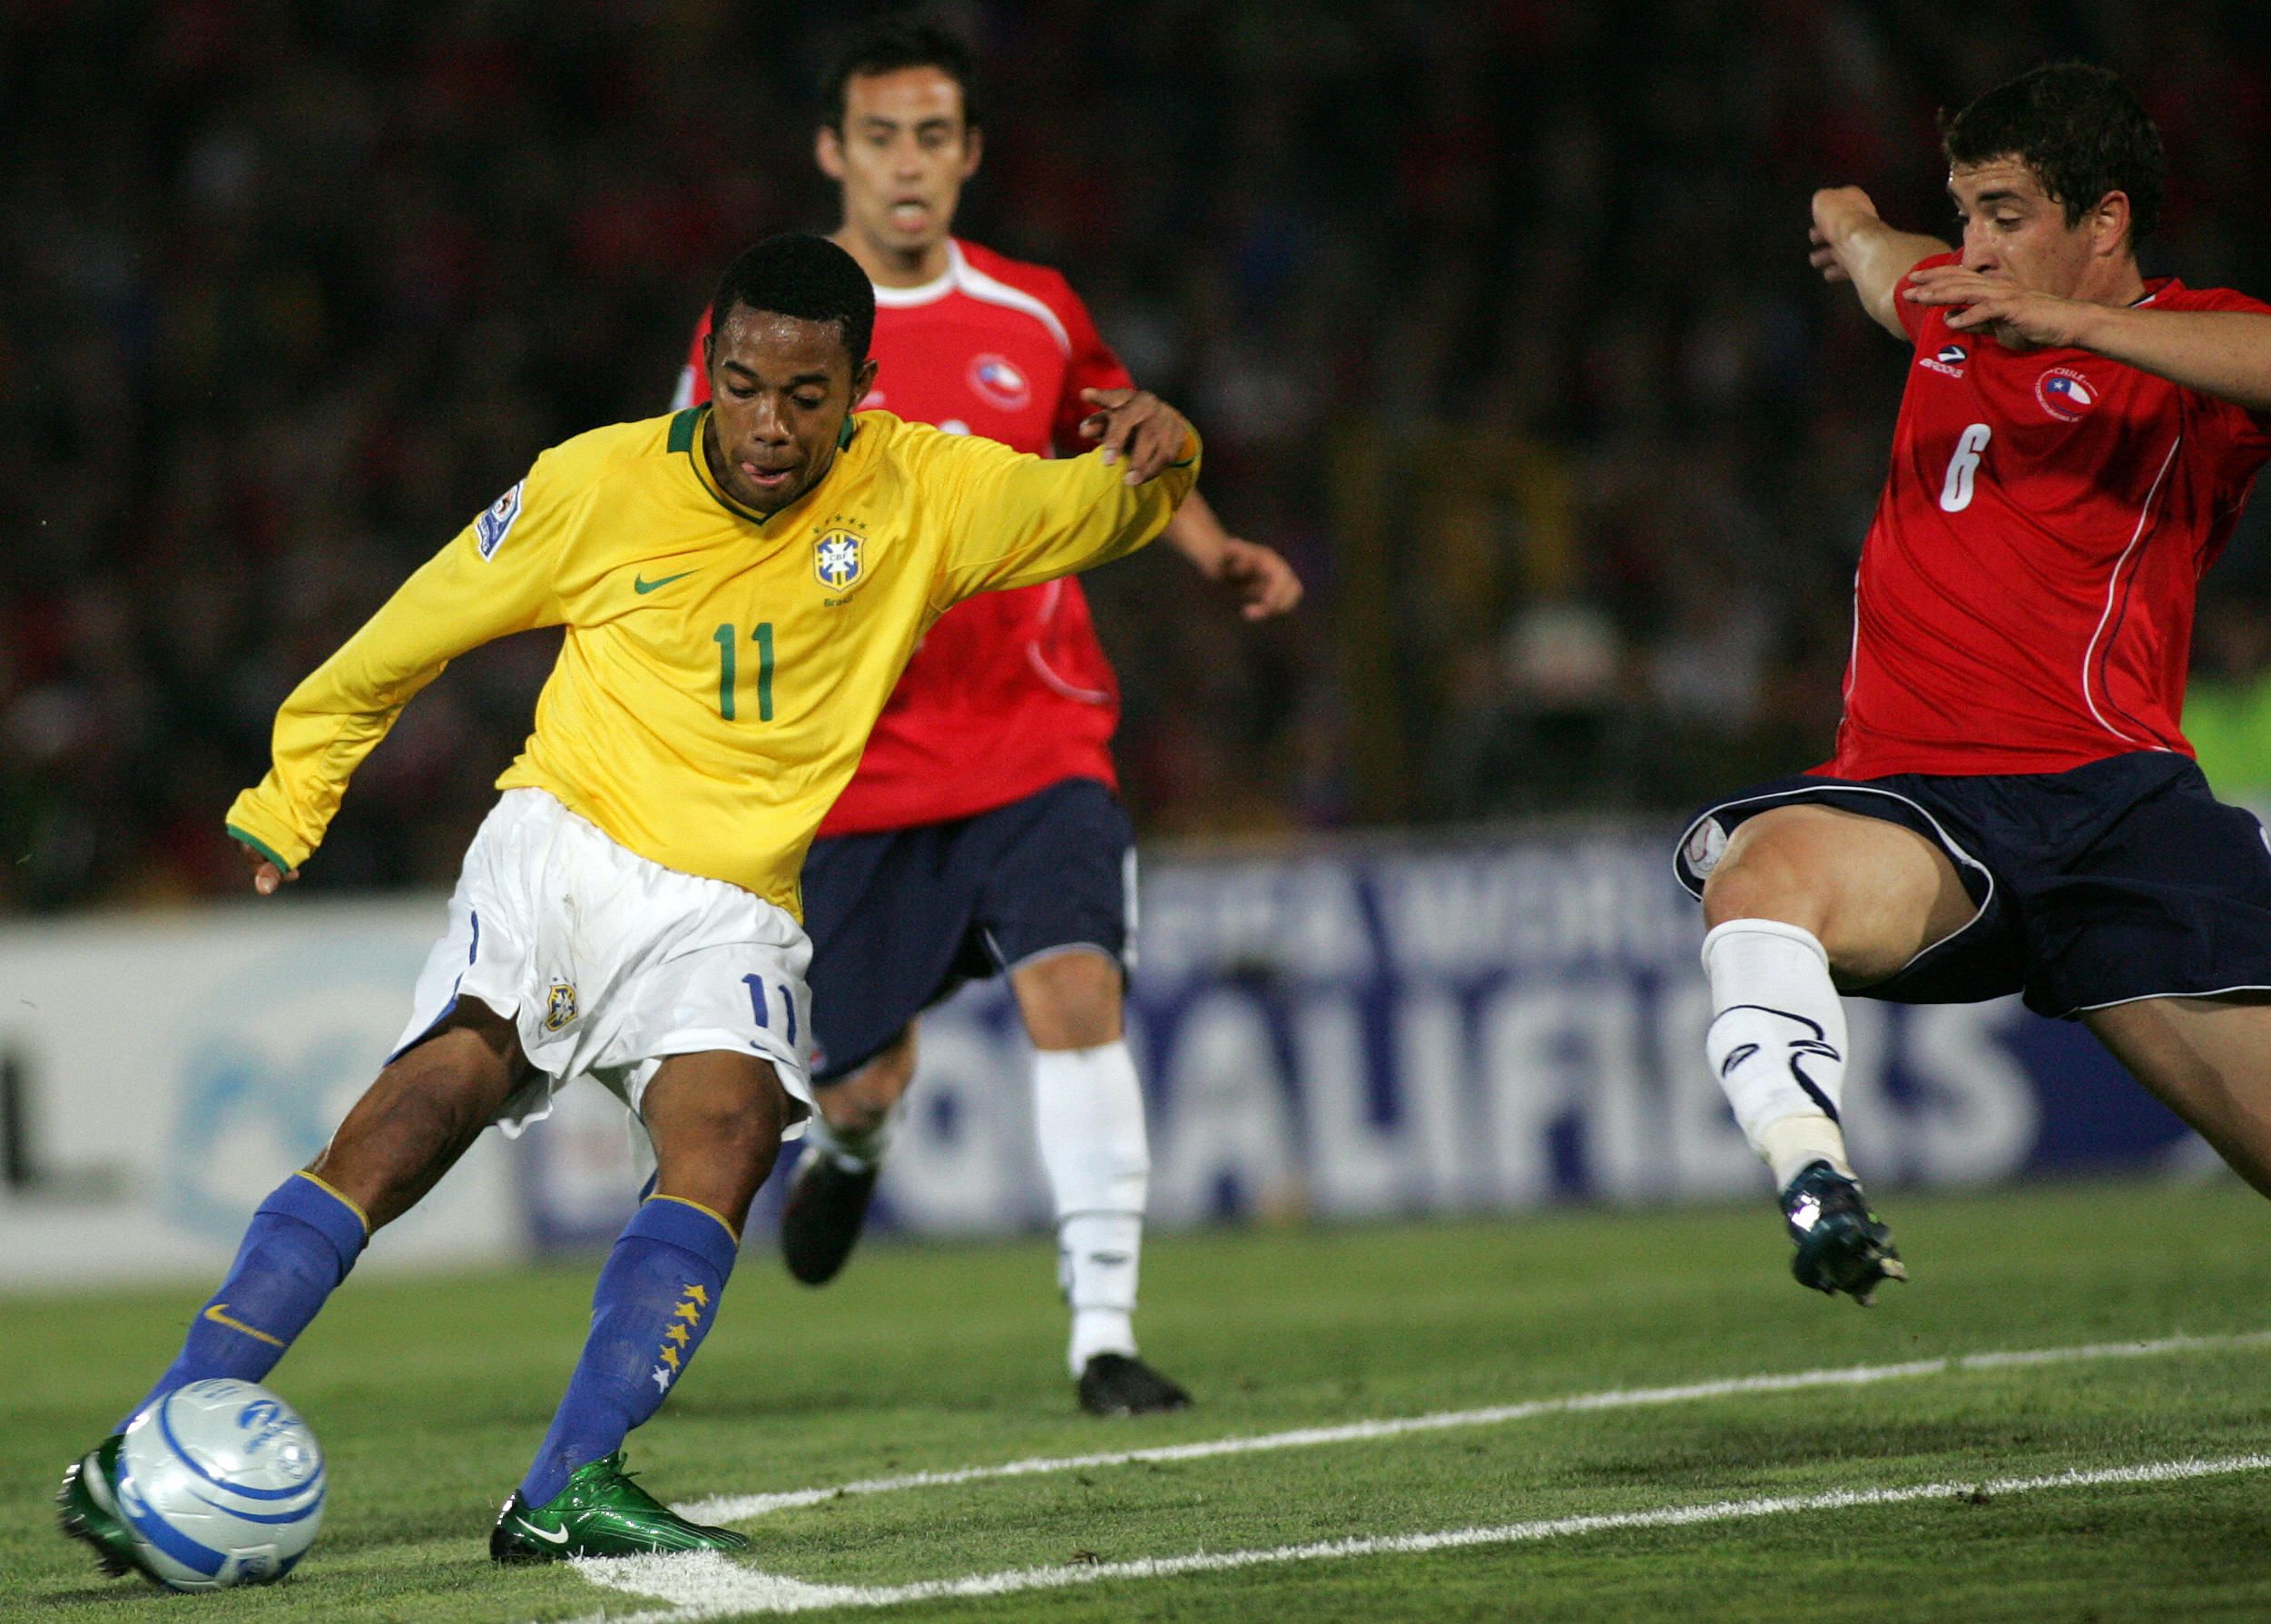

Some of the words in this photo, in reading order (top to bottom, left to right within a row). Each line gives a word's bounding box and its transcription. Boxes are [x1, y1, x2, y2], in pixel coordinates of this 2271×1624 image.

[1940, 423, 1991, 512] 6
[829, 552, 848, 562] CBF
[713, 622, 774, 723] 11
[741, 972, 797, 1048] 11
[876, 979, 2038, 1215] QALIFIES
